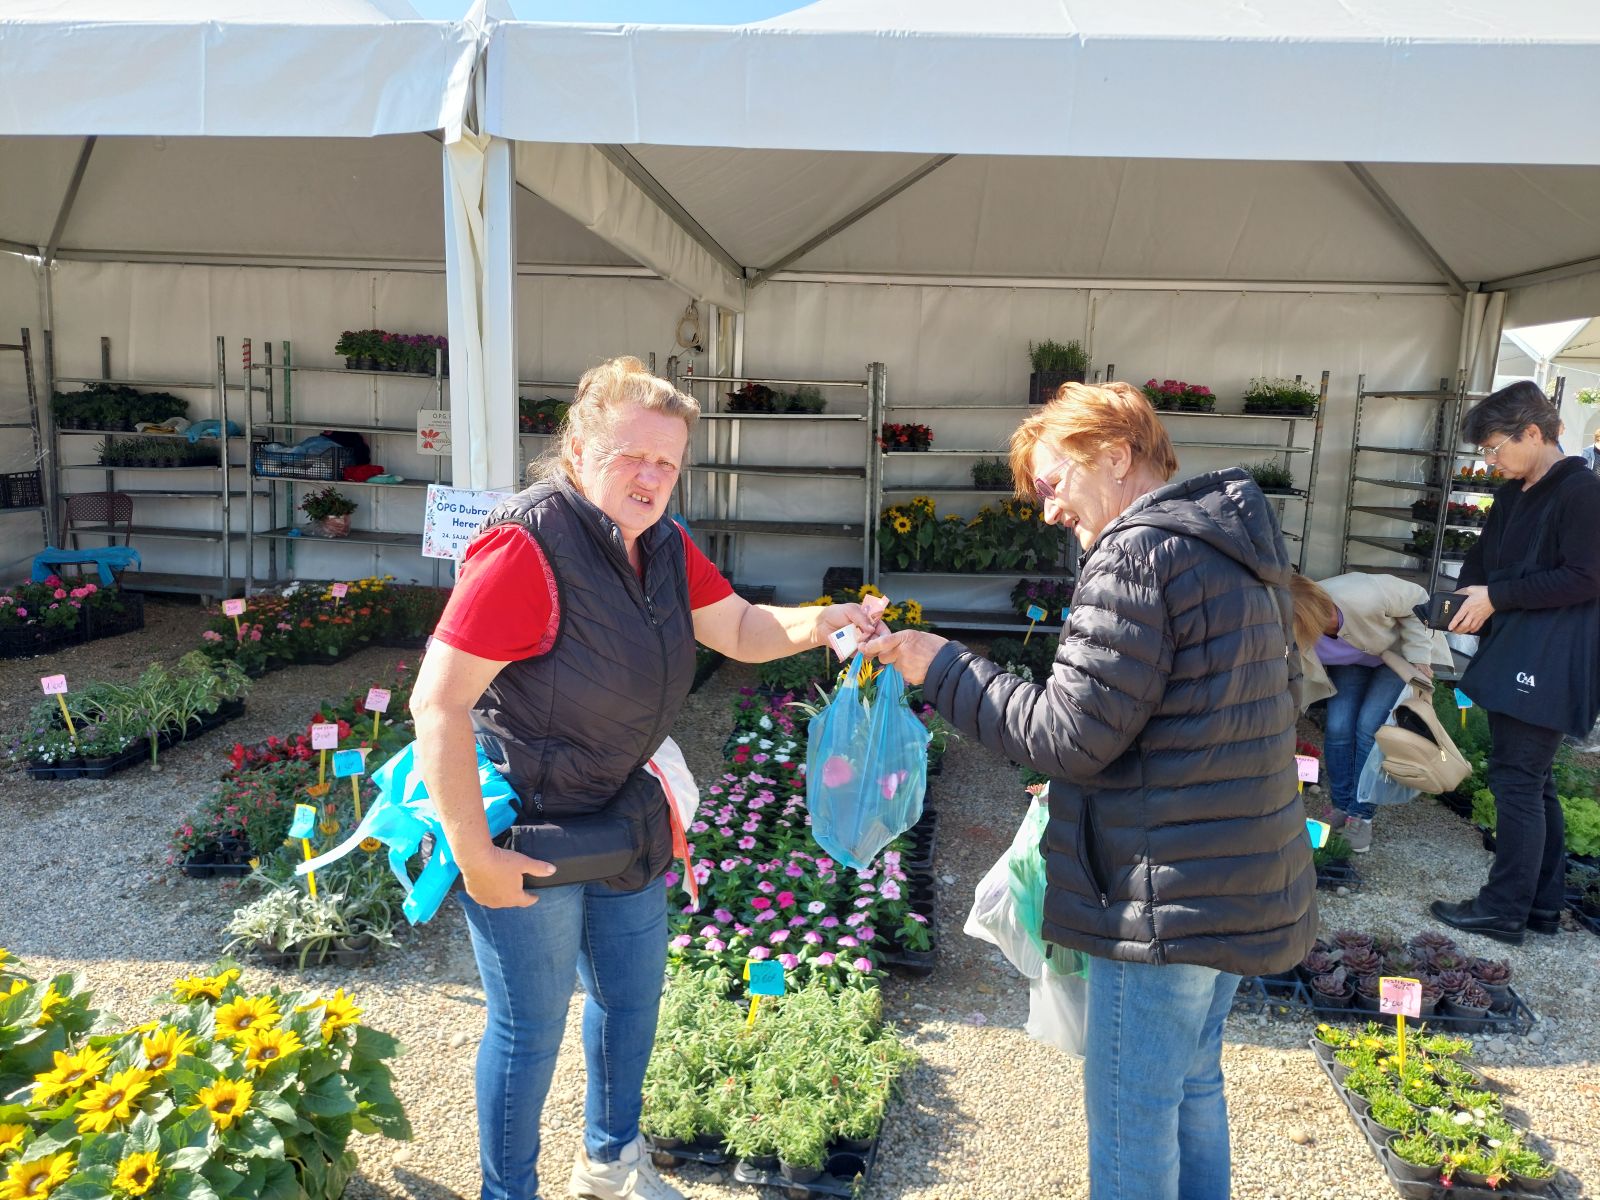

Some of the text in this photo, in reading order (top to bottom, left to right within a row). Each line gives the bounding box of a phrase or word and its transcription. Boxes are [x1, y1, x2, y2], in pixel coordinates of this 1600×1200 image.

[436, 502, 489, 516] OPG Dubro
[1516, 671, 1536, 687] C&A
